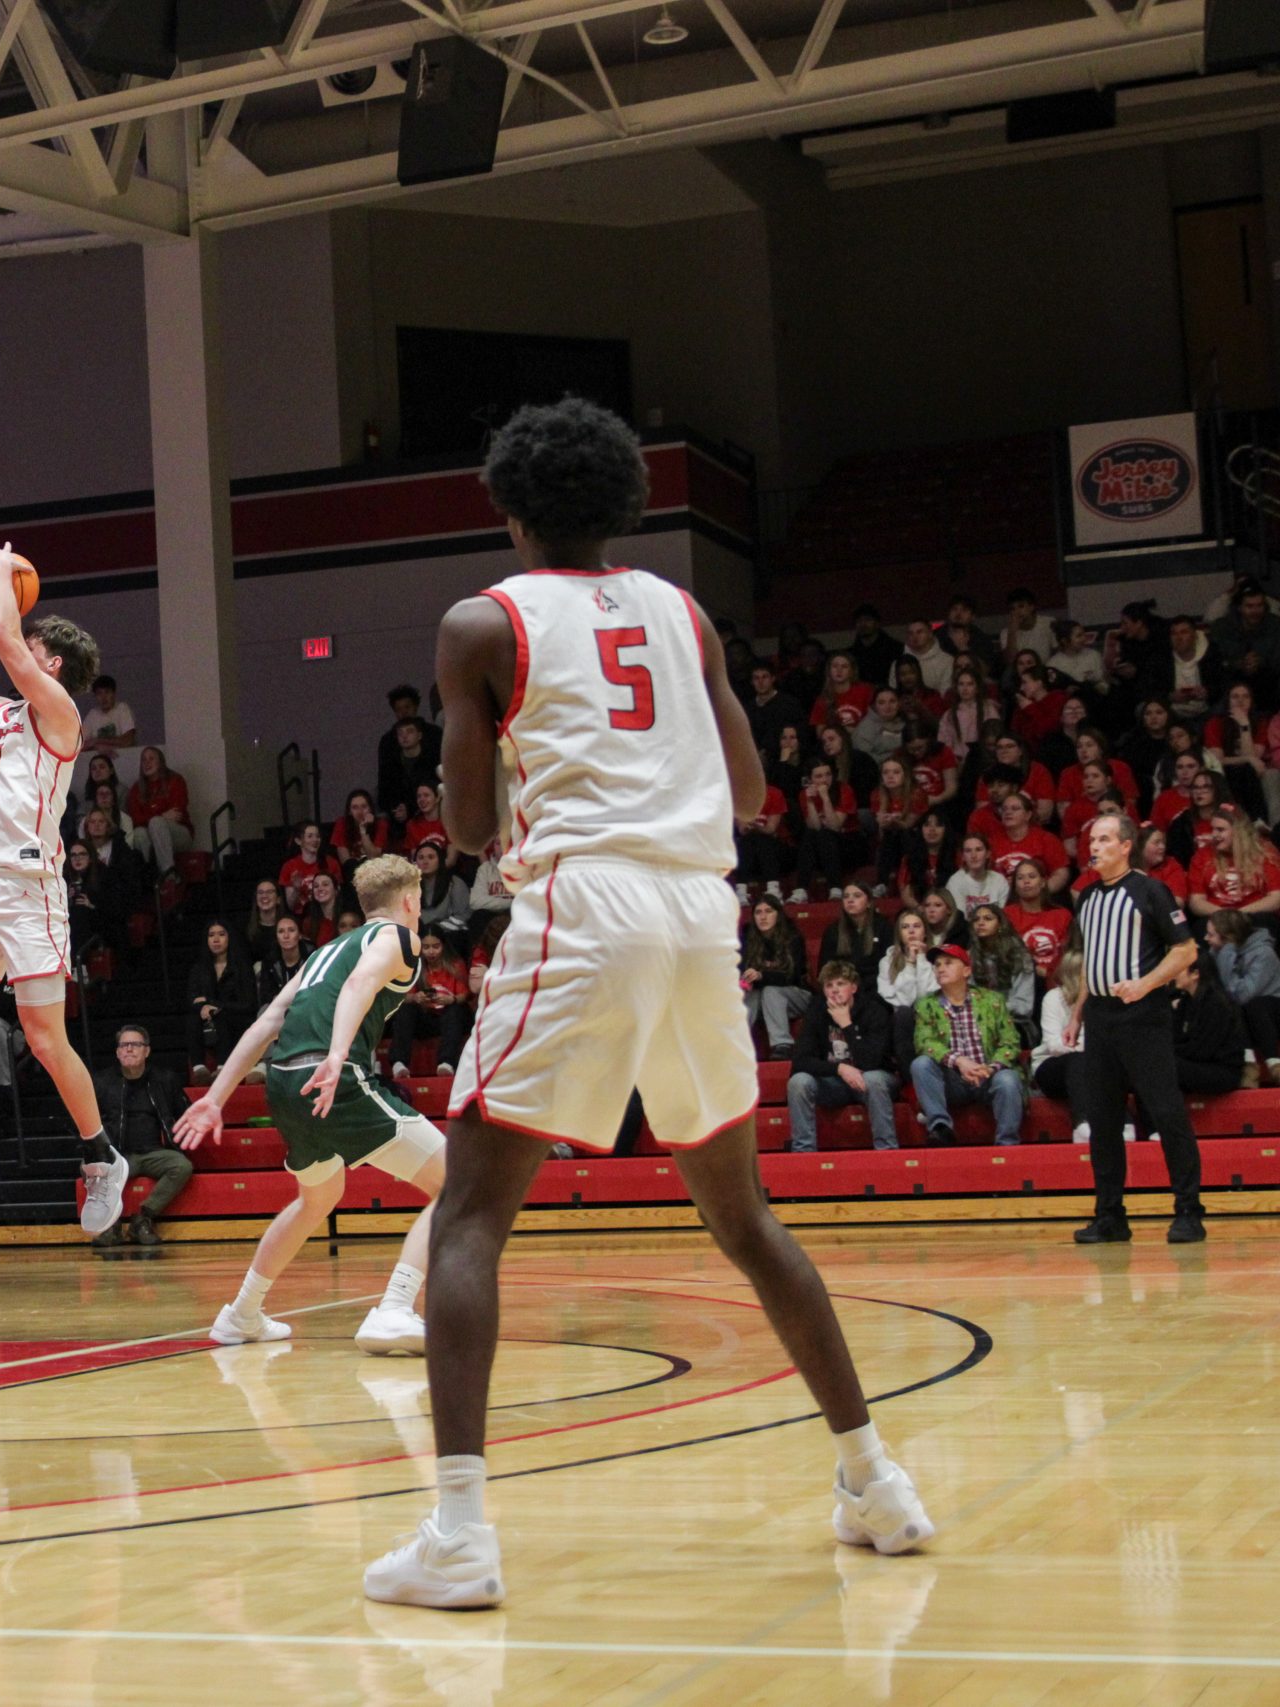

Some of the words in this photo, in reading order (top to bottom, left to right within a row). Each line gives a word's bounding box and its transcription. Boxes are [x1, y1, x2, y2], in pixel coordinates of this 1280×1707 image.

[1092, 457, 1178, 483] Jersey
[306, 638, 329, 657] EXIT
[593, 625, 655, 731] 5
[297, 936, 352, 991] 11
